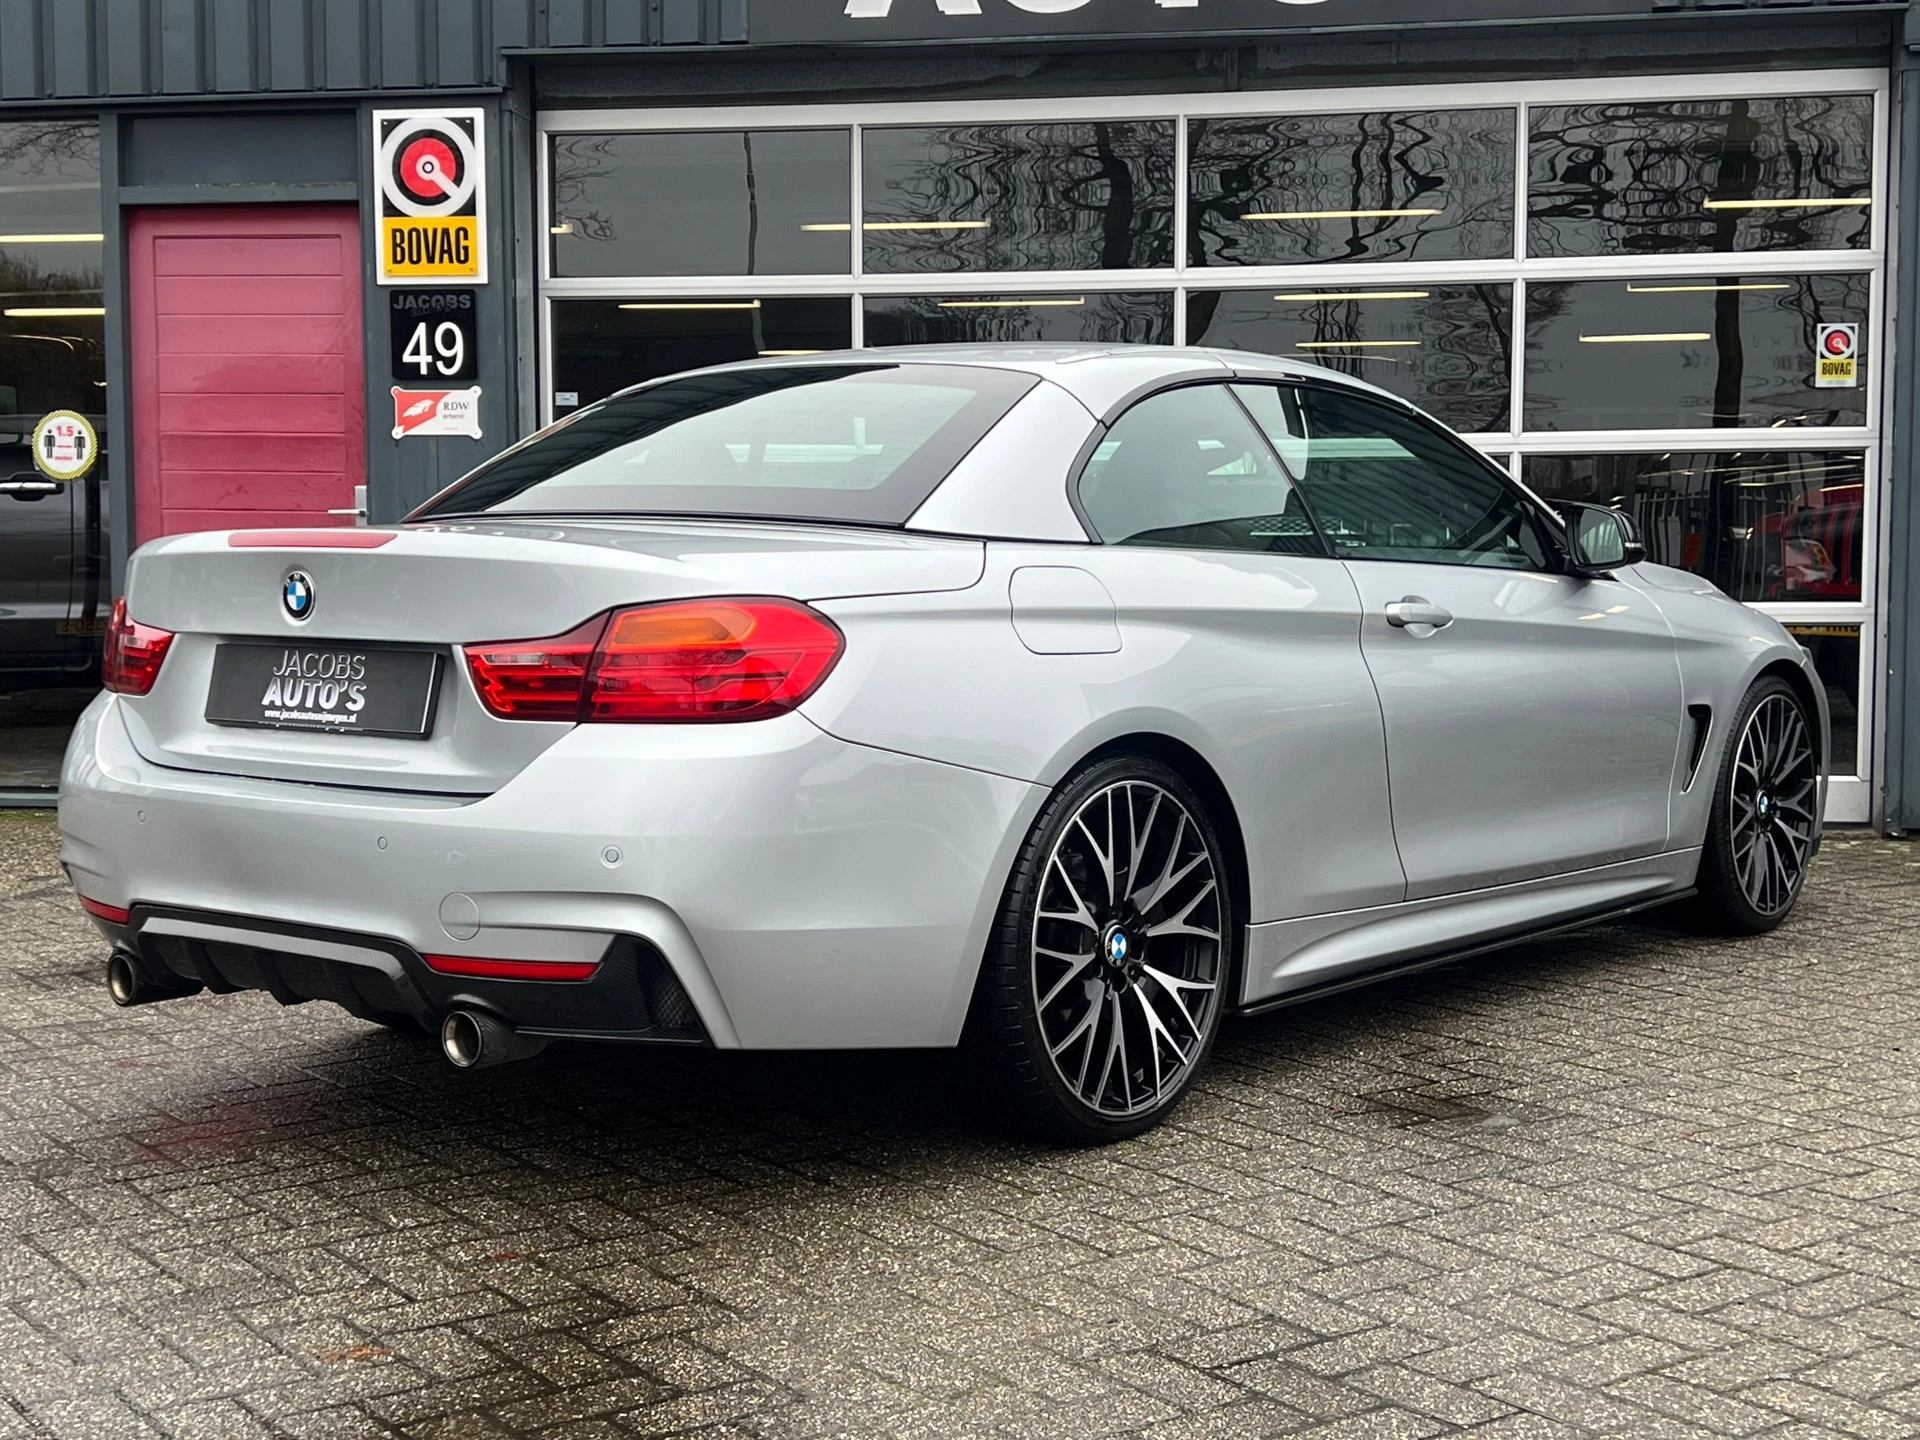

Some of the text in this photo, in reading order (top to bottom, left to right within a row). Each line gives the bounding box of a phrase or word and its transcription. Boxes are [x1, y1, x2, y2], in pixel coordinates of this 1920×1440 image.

[391, 227, 469, 264] BOVAG
[393, 294, 471, 310] JACOBS
[402, 321, 464, 376] 49
[1822, 362, 1851, 376] BOVAG
[443, 401, 470, 411] RDW
[56, 425, 74, 437] 1.5
[272, 650, 367, 680] JACOBS
[261, 677, 367, 711] AUTO'S
